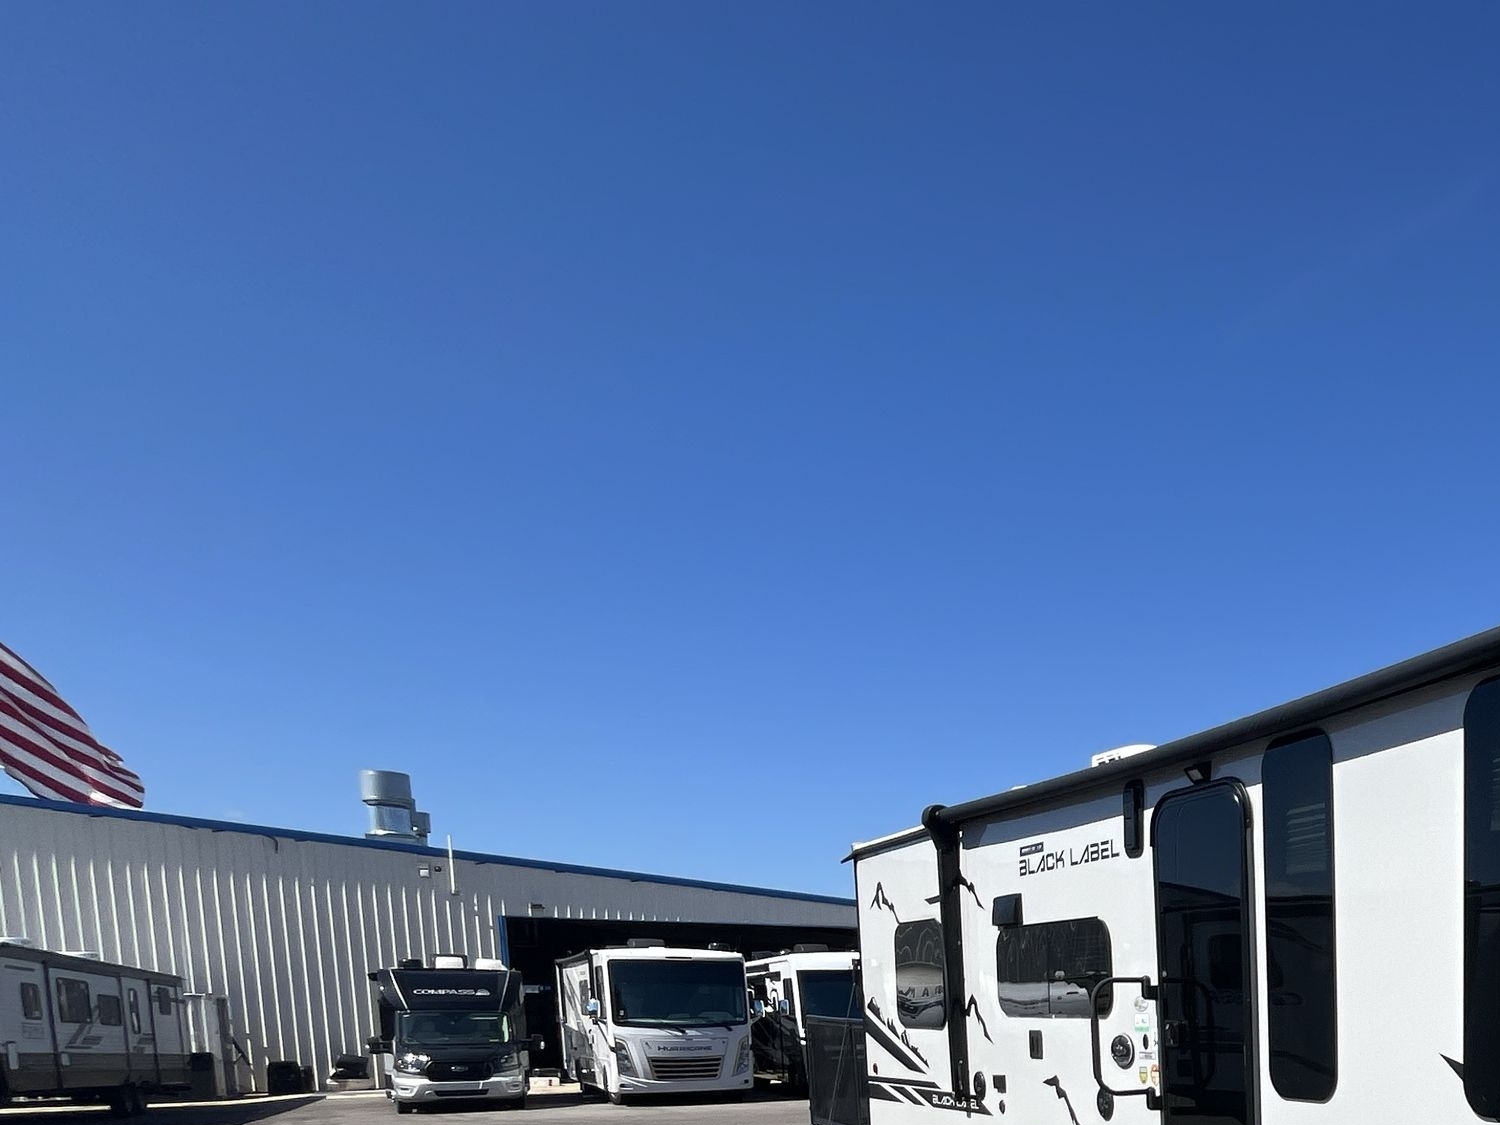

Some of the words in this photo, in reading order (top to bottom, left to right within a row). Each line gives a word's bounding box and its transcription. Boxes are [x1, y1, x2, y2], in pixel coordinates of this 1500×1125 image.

[1019, 849, 1065, 876] BLACK
[1069, 839, 1120, 866] LABEL
[412, 988, 476, 996] COMPASS
